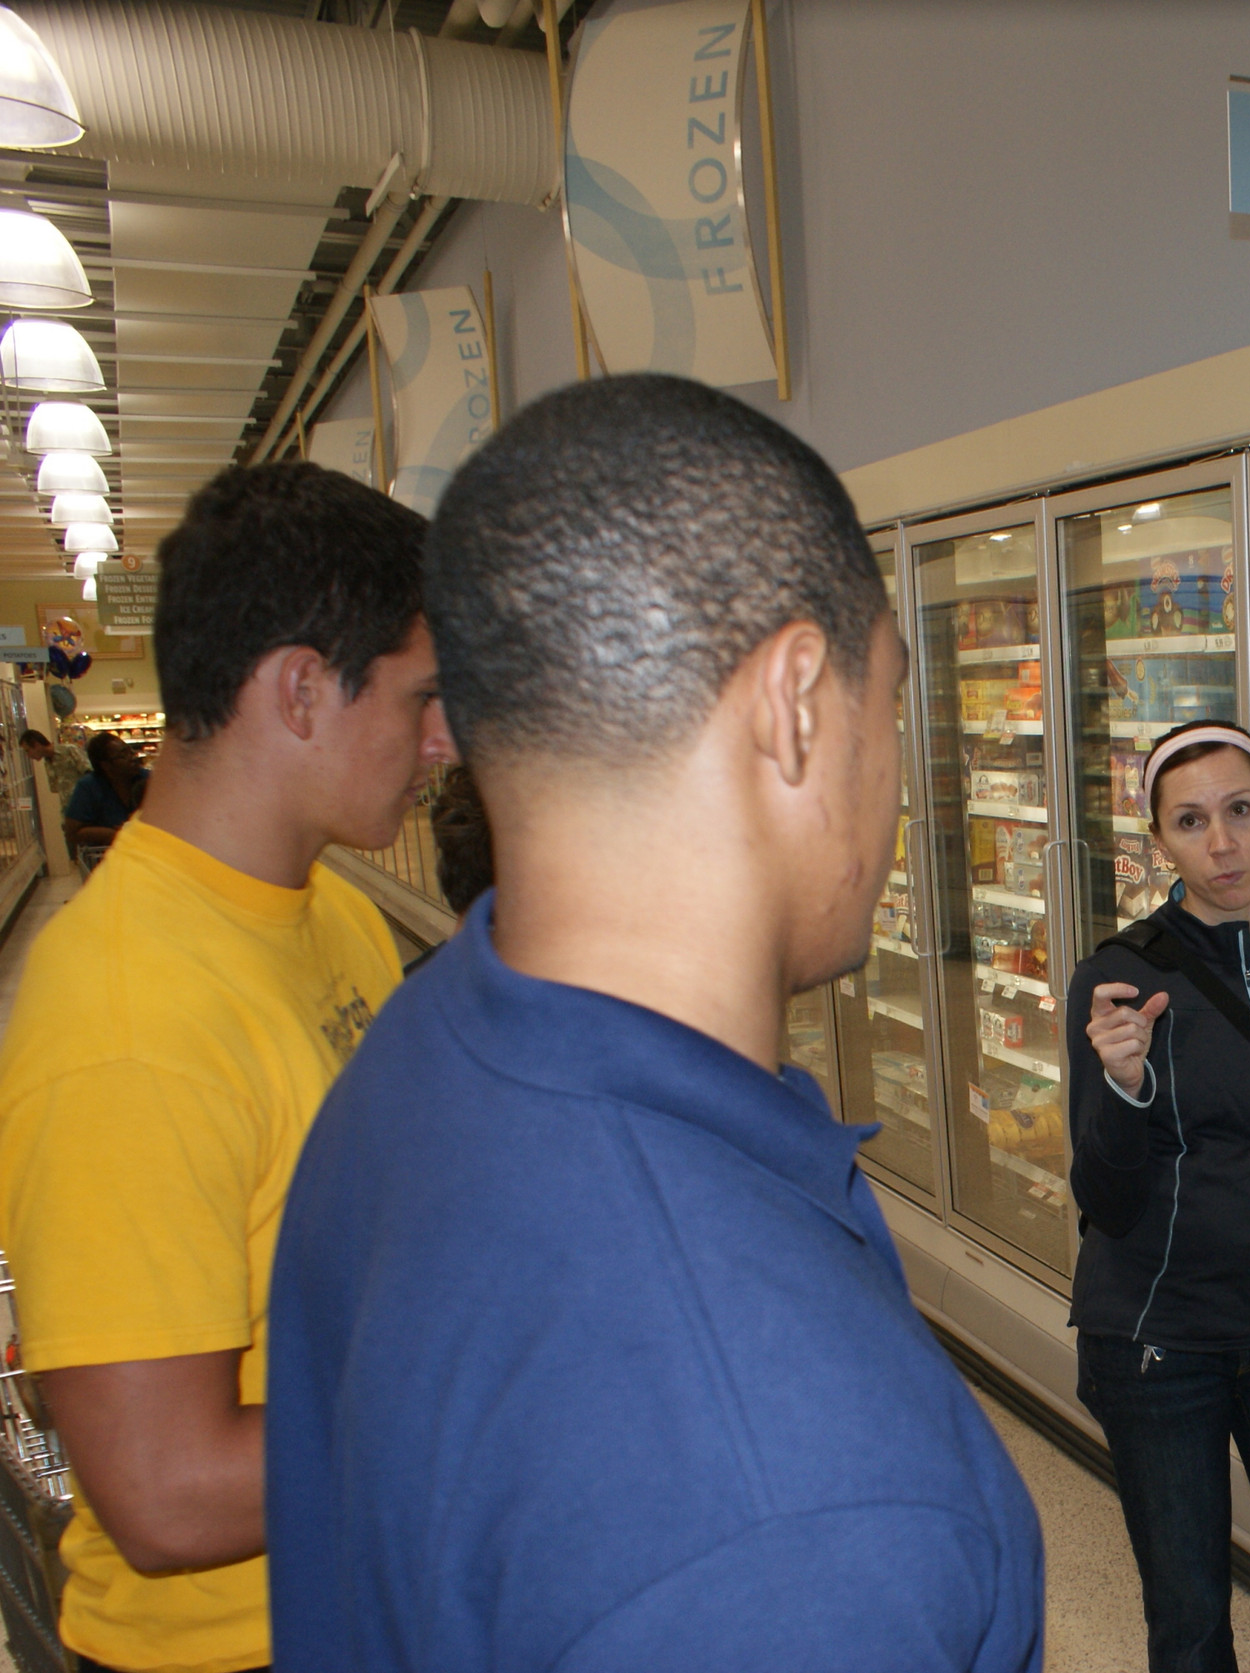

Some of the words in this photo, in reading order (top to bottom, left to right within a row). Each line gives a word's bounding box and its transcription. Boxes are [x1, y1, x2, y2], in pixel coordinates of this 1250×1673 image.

[688, 21, 743, 297] FROZEN
[448, 308, 490, 444] ROZEN
[351, 430, 371, 482] ZEN
[127, 556, 136, 569] 9
